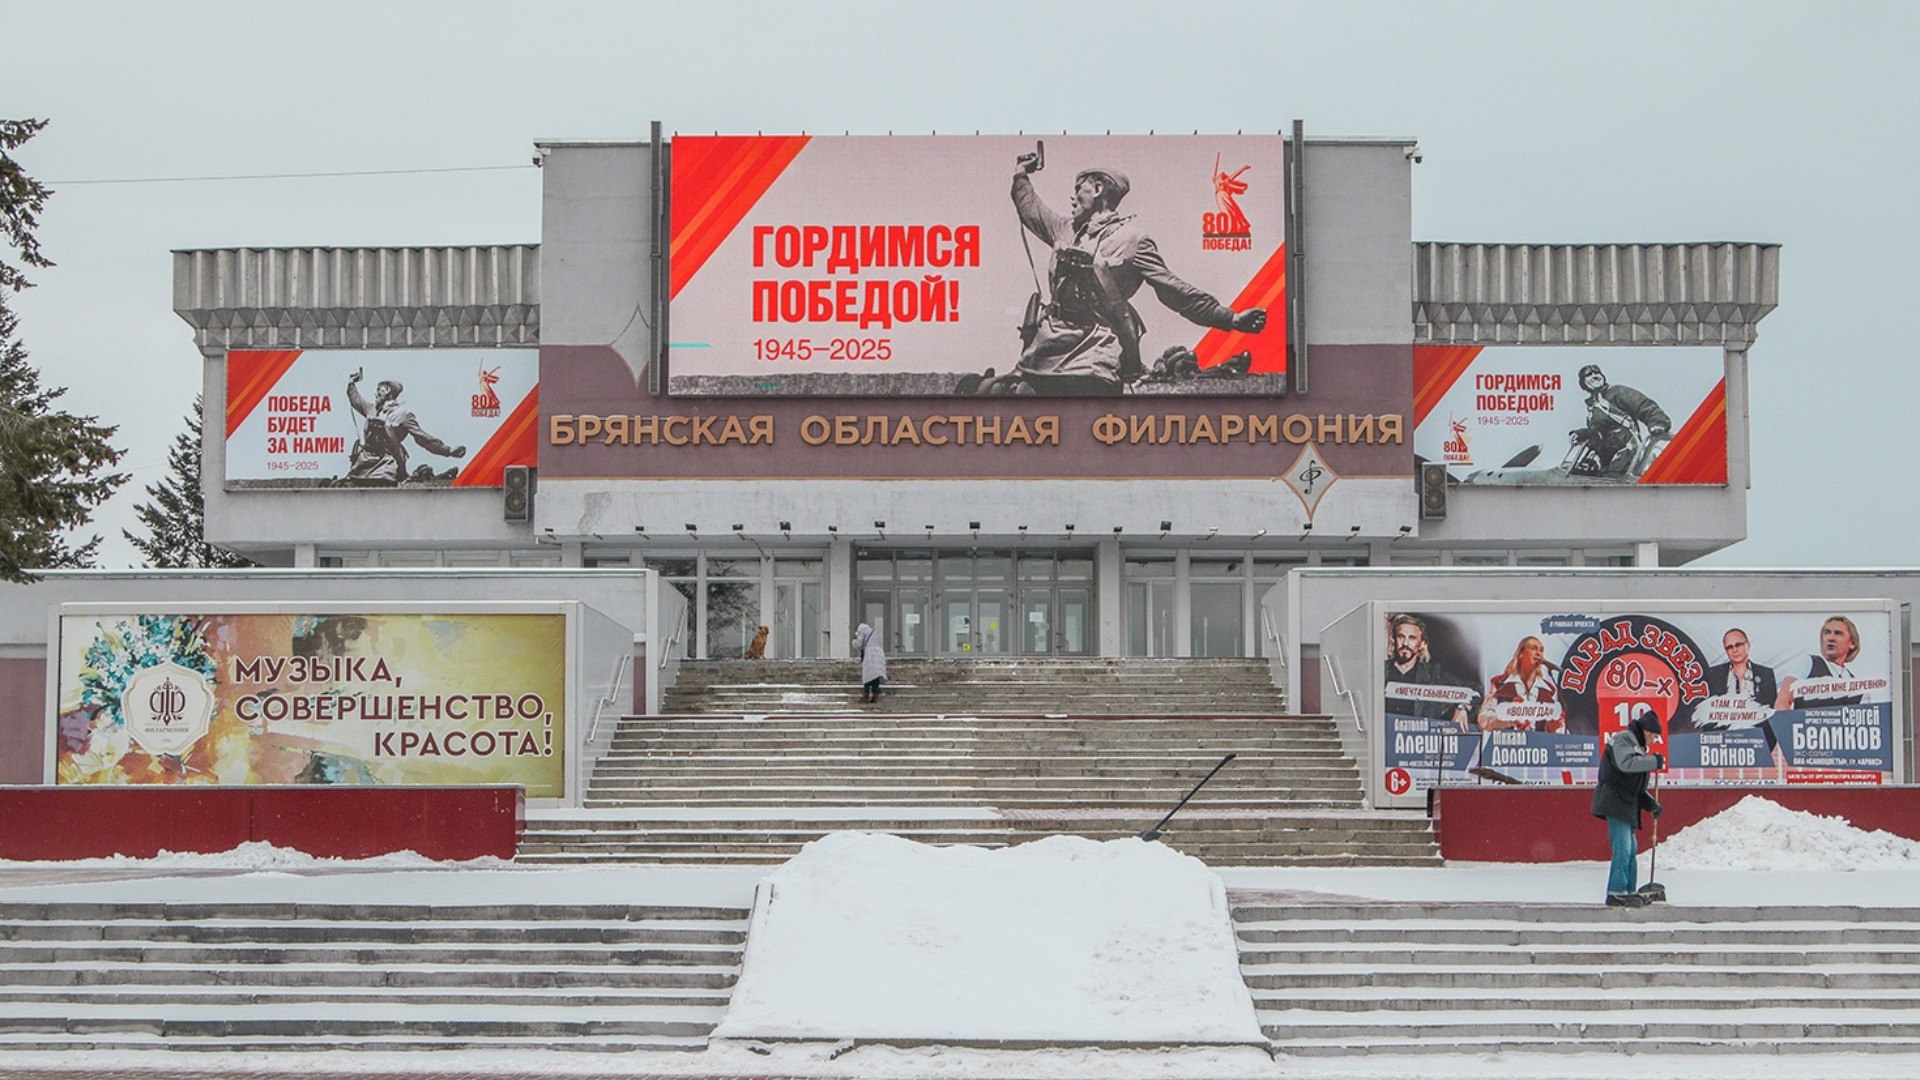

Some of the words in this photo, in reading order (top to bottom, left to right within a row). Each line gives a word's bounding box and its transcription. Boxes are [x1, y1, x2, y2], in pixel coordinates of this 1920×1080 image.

[1203, 212, 1229, 234] 80
[753, 225, 980, 274] ГОРДИМСЯ
[1203, 238, 1251, 252] ПОБЕДА!
[753, 276, 960, 328] ПОБЕДОЙ!
[1476, 374, 1561, 392] ГОРДИМСЯ
[267, 396, 331, 414] ПОБЕДА
[472, 394, 487, 408] 80
[1476, 393, 1554, 412] ПОБЕДОЙ!
[267, 417, 316, 434] БУДЕТ
[549, 414, 774, 445] БРЯНСКАЯ
[800, 414, 1060, 445] ОБЛАСТНАЯ
[1092, 414, 1403, 445] ФИЛАРМОНИЯ
[267, 437, 288, 454] ЗА
[293, 437, 344, 454] НАМИ!
[1443, 440, 1457, 453] 80
[235, 657, 402, 687] МУЗЫКА,
[1561, 621, 1638, 694] ПАРАД
[1641, 625, 1710, 704] ЗВЕЗД
[1797, 684, 1830, 694] «СНИТСЯ
[1831, 682, 1847, 692] МНЕ
[1849, 679, 1887, 692] ДЕРЕВНЯ»
[234, 694, 553, 728] СОВЕРШЕНСТВО,
[1506, 706, 1554, 716] «ВОЛОГДА»
[1733, 700, 1746, 708] ГДЕ
[1708, 712, 1728, 720] КЛЕН
[1842, 706, 1880, 727] Сергей
[374, 730, 553, 757] КРАСОТА!
[1793, 724, 1882, 750] Беликов
[1492, 746, 1548, 766] Долотов
[1701, 744, 1755, 766] Войнов
[1391, 771, 1407, 792] 6+
